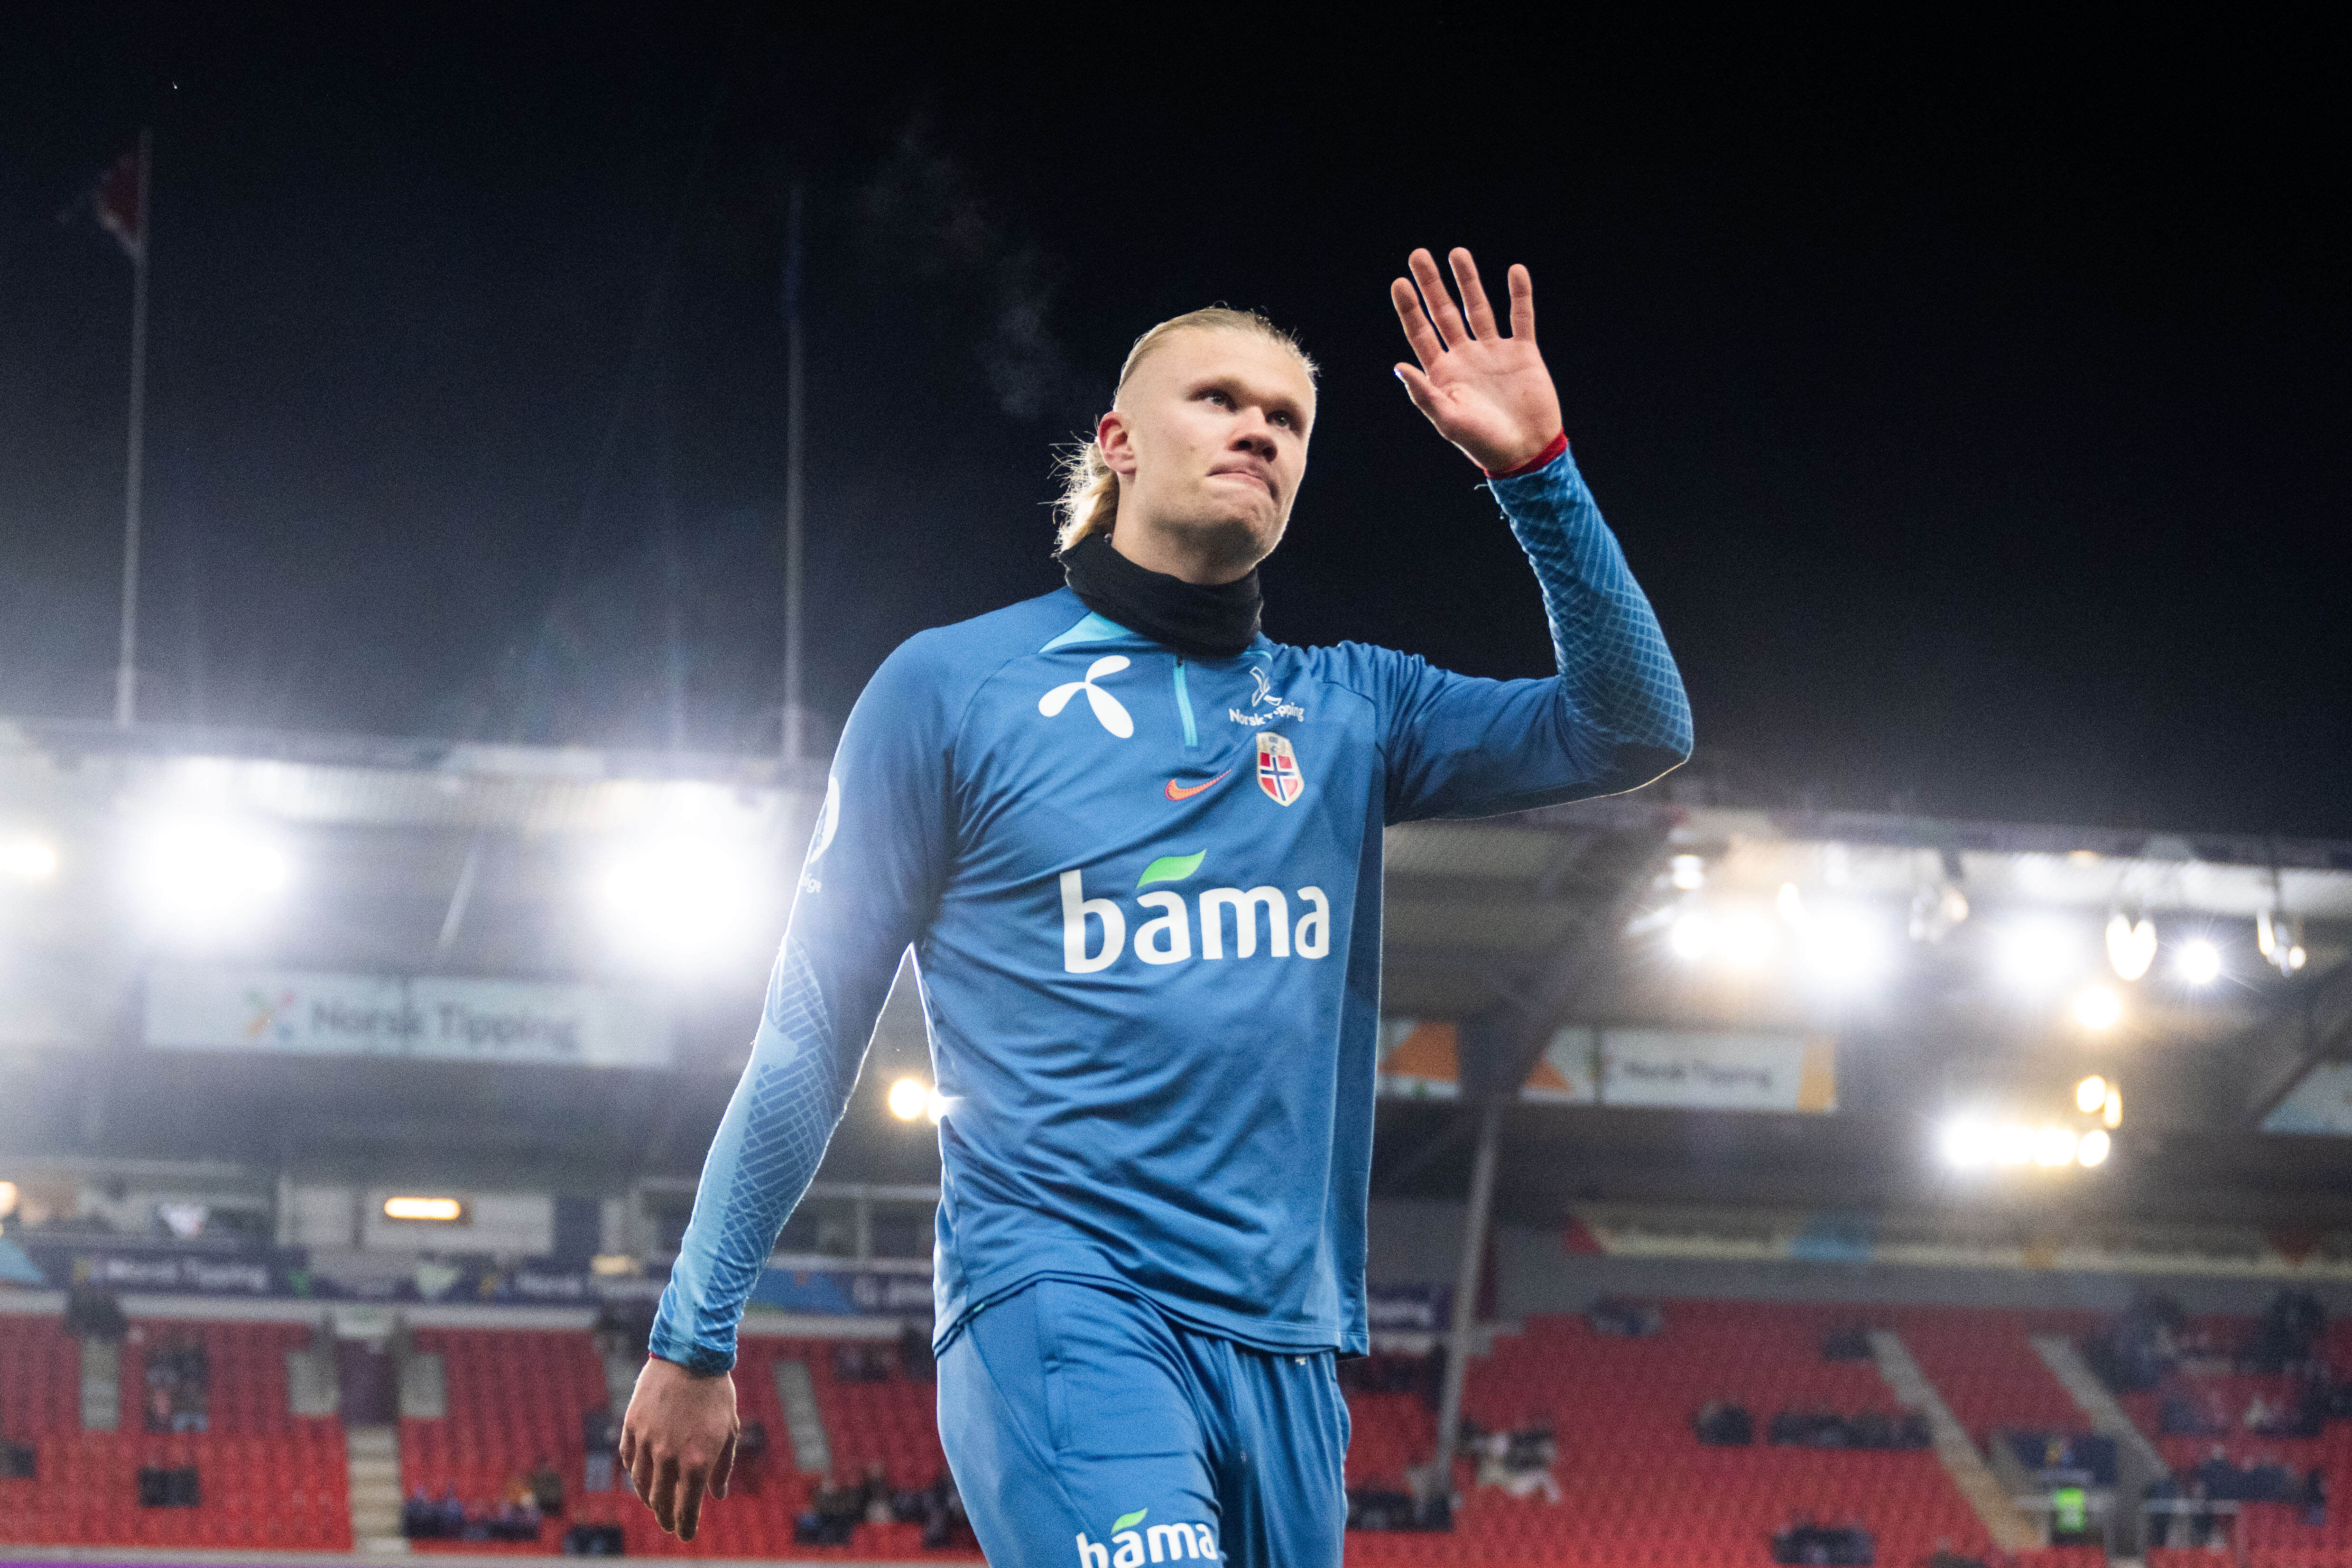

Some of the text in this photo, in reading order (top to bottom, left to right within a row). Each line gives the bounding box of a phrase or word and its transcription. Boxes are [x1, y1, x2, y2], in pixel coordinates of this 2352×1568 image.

[1228, 708, 1266, 726] Norsk
[1059, 869, 1330, 974] bama
[1075, 1522, 1218, 1568] bama
